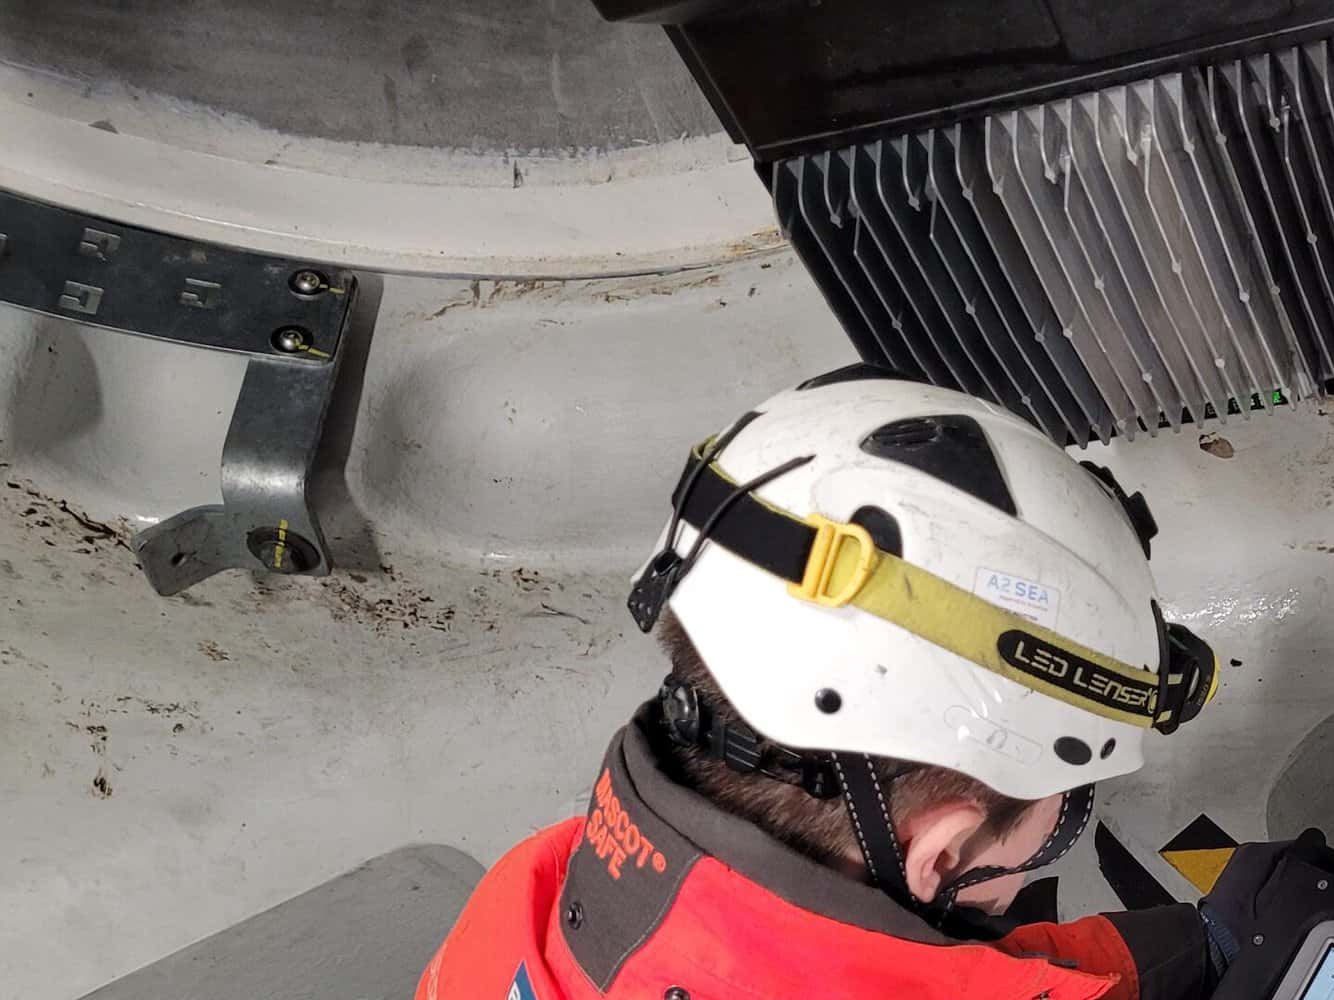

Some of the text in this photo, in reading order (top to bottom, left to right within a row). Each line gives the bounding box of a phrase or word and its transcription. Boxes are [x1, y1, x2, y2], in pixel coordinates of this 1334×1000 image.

[987, 574, 1011, 593] A2
[1015, 582, 1049, 605] SEA
[1015, 640, 1068, 678] LED
